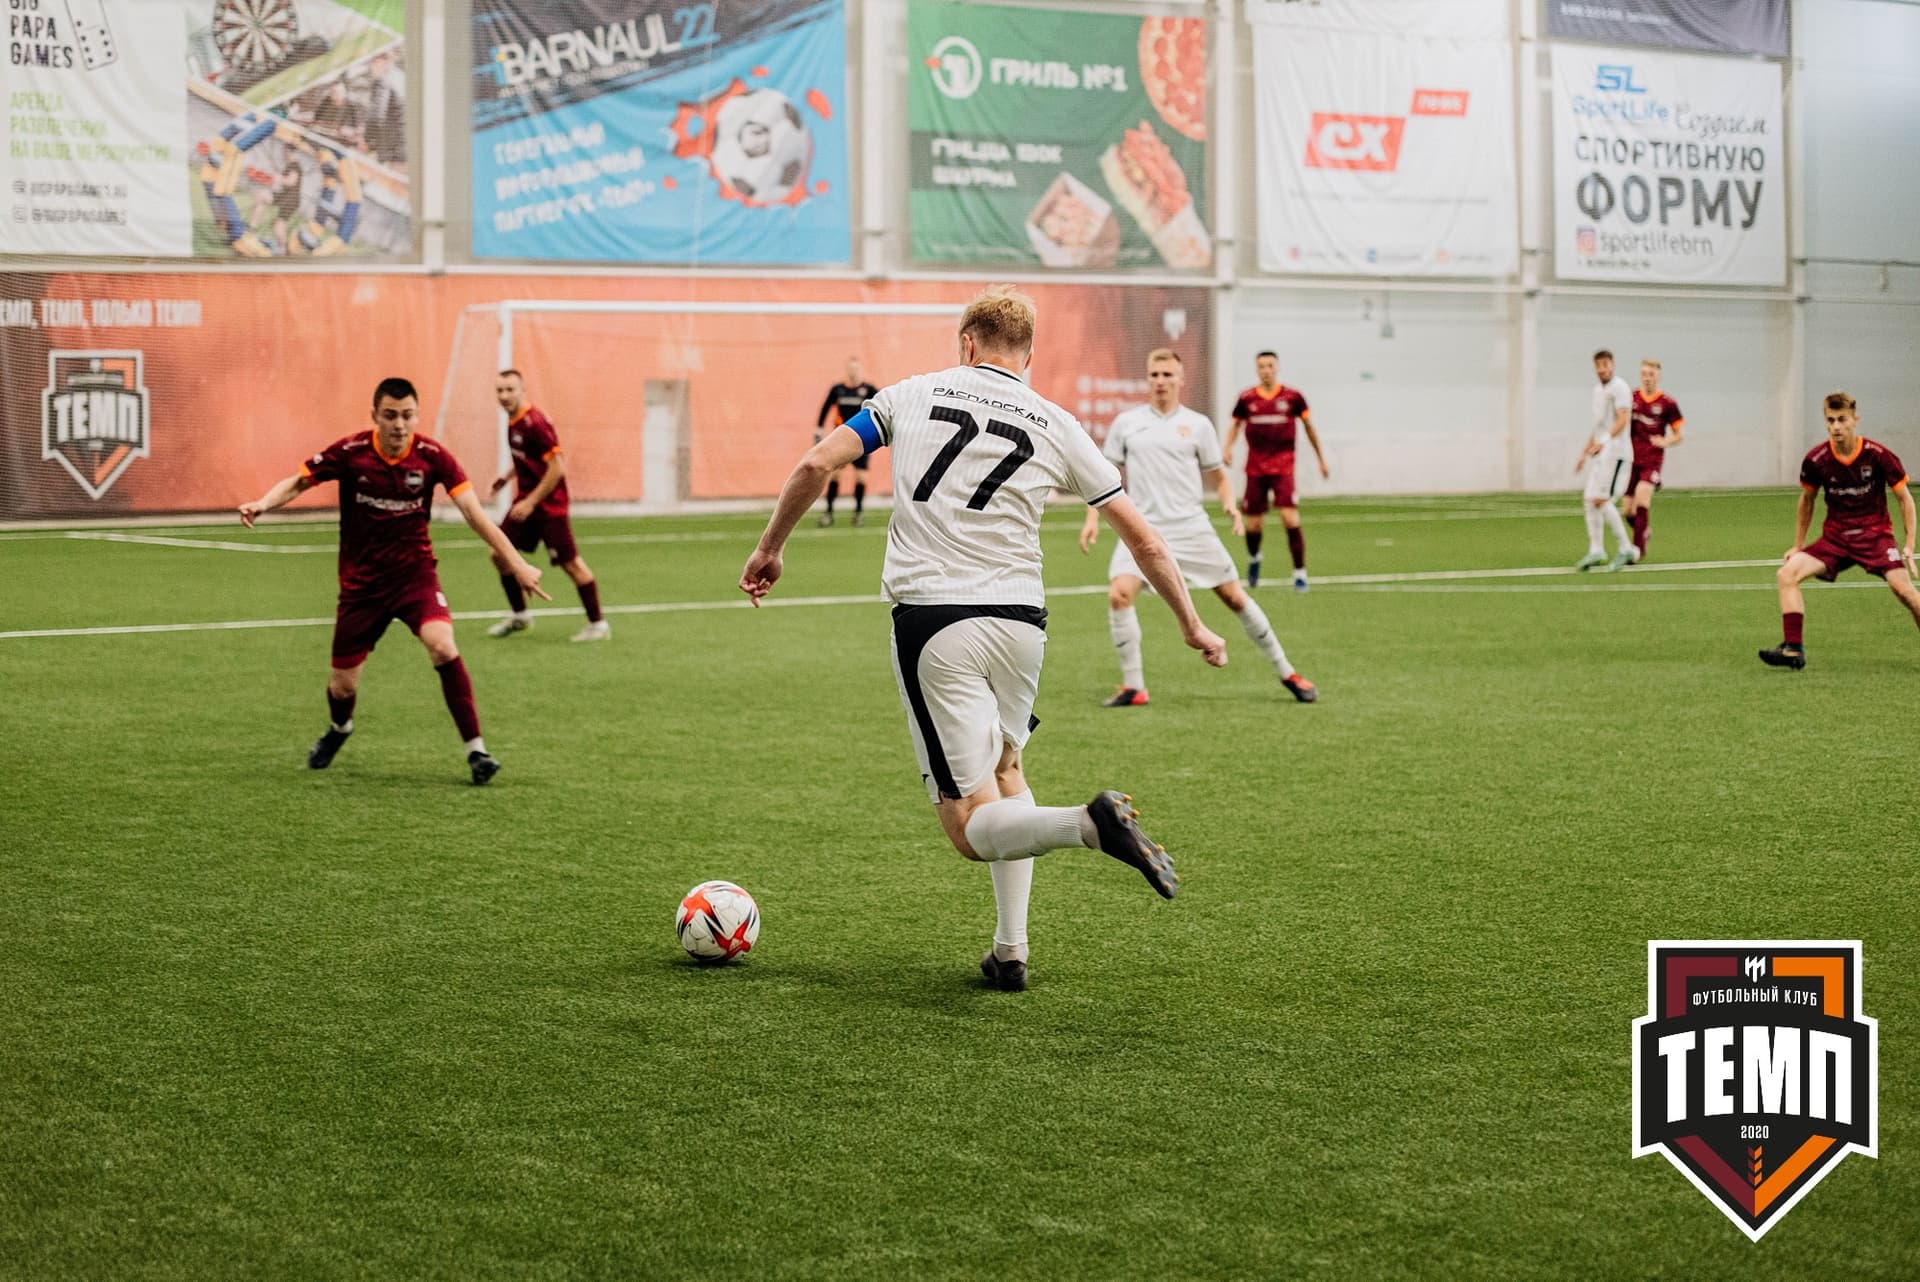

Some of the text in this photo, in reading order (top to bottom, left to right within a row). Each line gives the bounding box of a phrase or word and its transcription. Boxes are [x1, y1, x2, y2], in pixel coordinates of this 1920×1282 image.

[11, 14, 57, 39] PAPA
[11, 42, 73, 68] GAMES
[990, 57, 1079, 89] ГРИЛЬ
[1576, 135, 1766, 172] СПОРТИВНУЮ
[1576, 172, 1763, 230] ФОРМУ
[53, 390, 139, 444] ТЕМП
[912, 405, 1035, 511] 77
